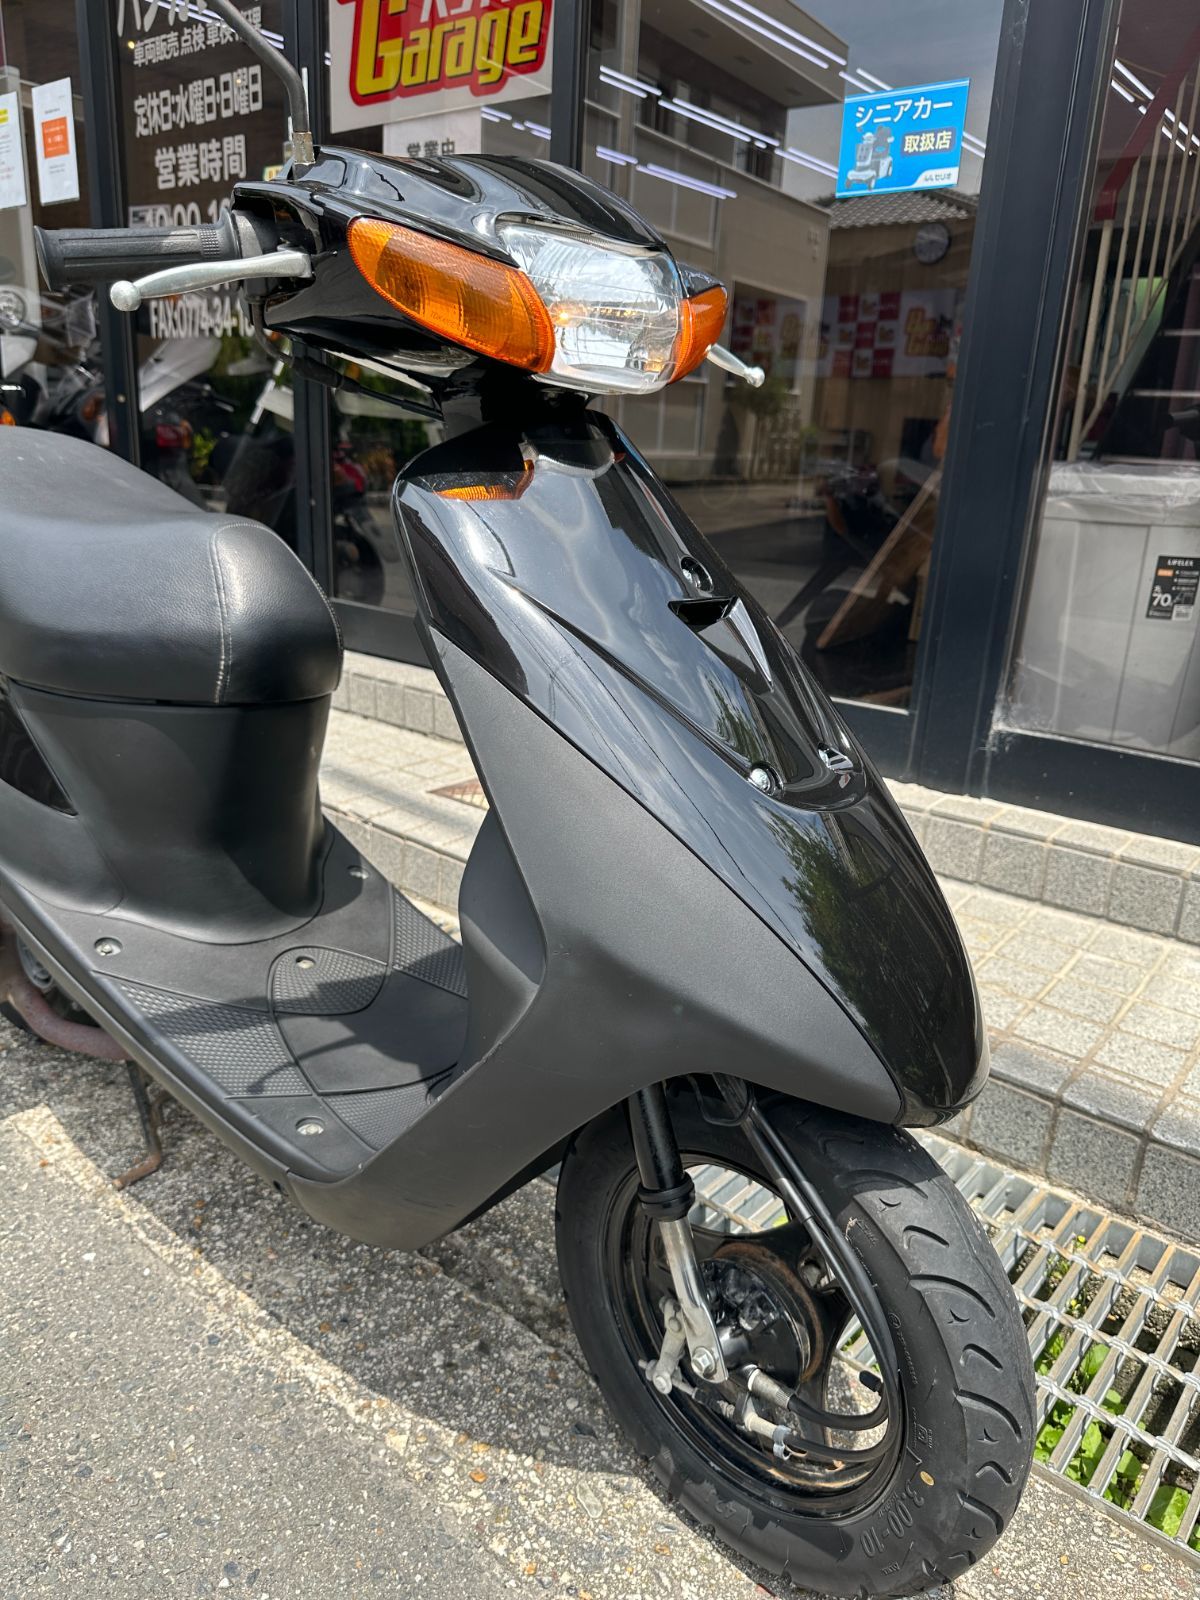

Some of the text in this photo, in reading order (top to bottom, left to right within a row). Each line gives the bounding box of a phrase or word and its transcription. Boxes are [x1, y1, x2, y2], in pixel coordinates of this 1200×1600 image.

[356, 0, 543, 96] Garage
[855, 96, 953, 128] シニアカー
[155, 134, 247, 190] 営業時間
[903, 130, 953, 153] 取扱店
[1152, 592, 1172, 607] 70
[860, 1479, 925, 1558] 3.00-10
